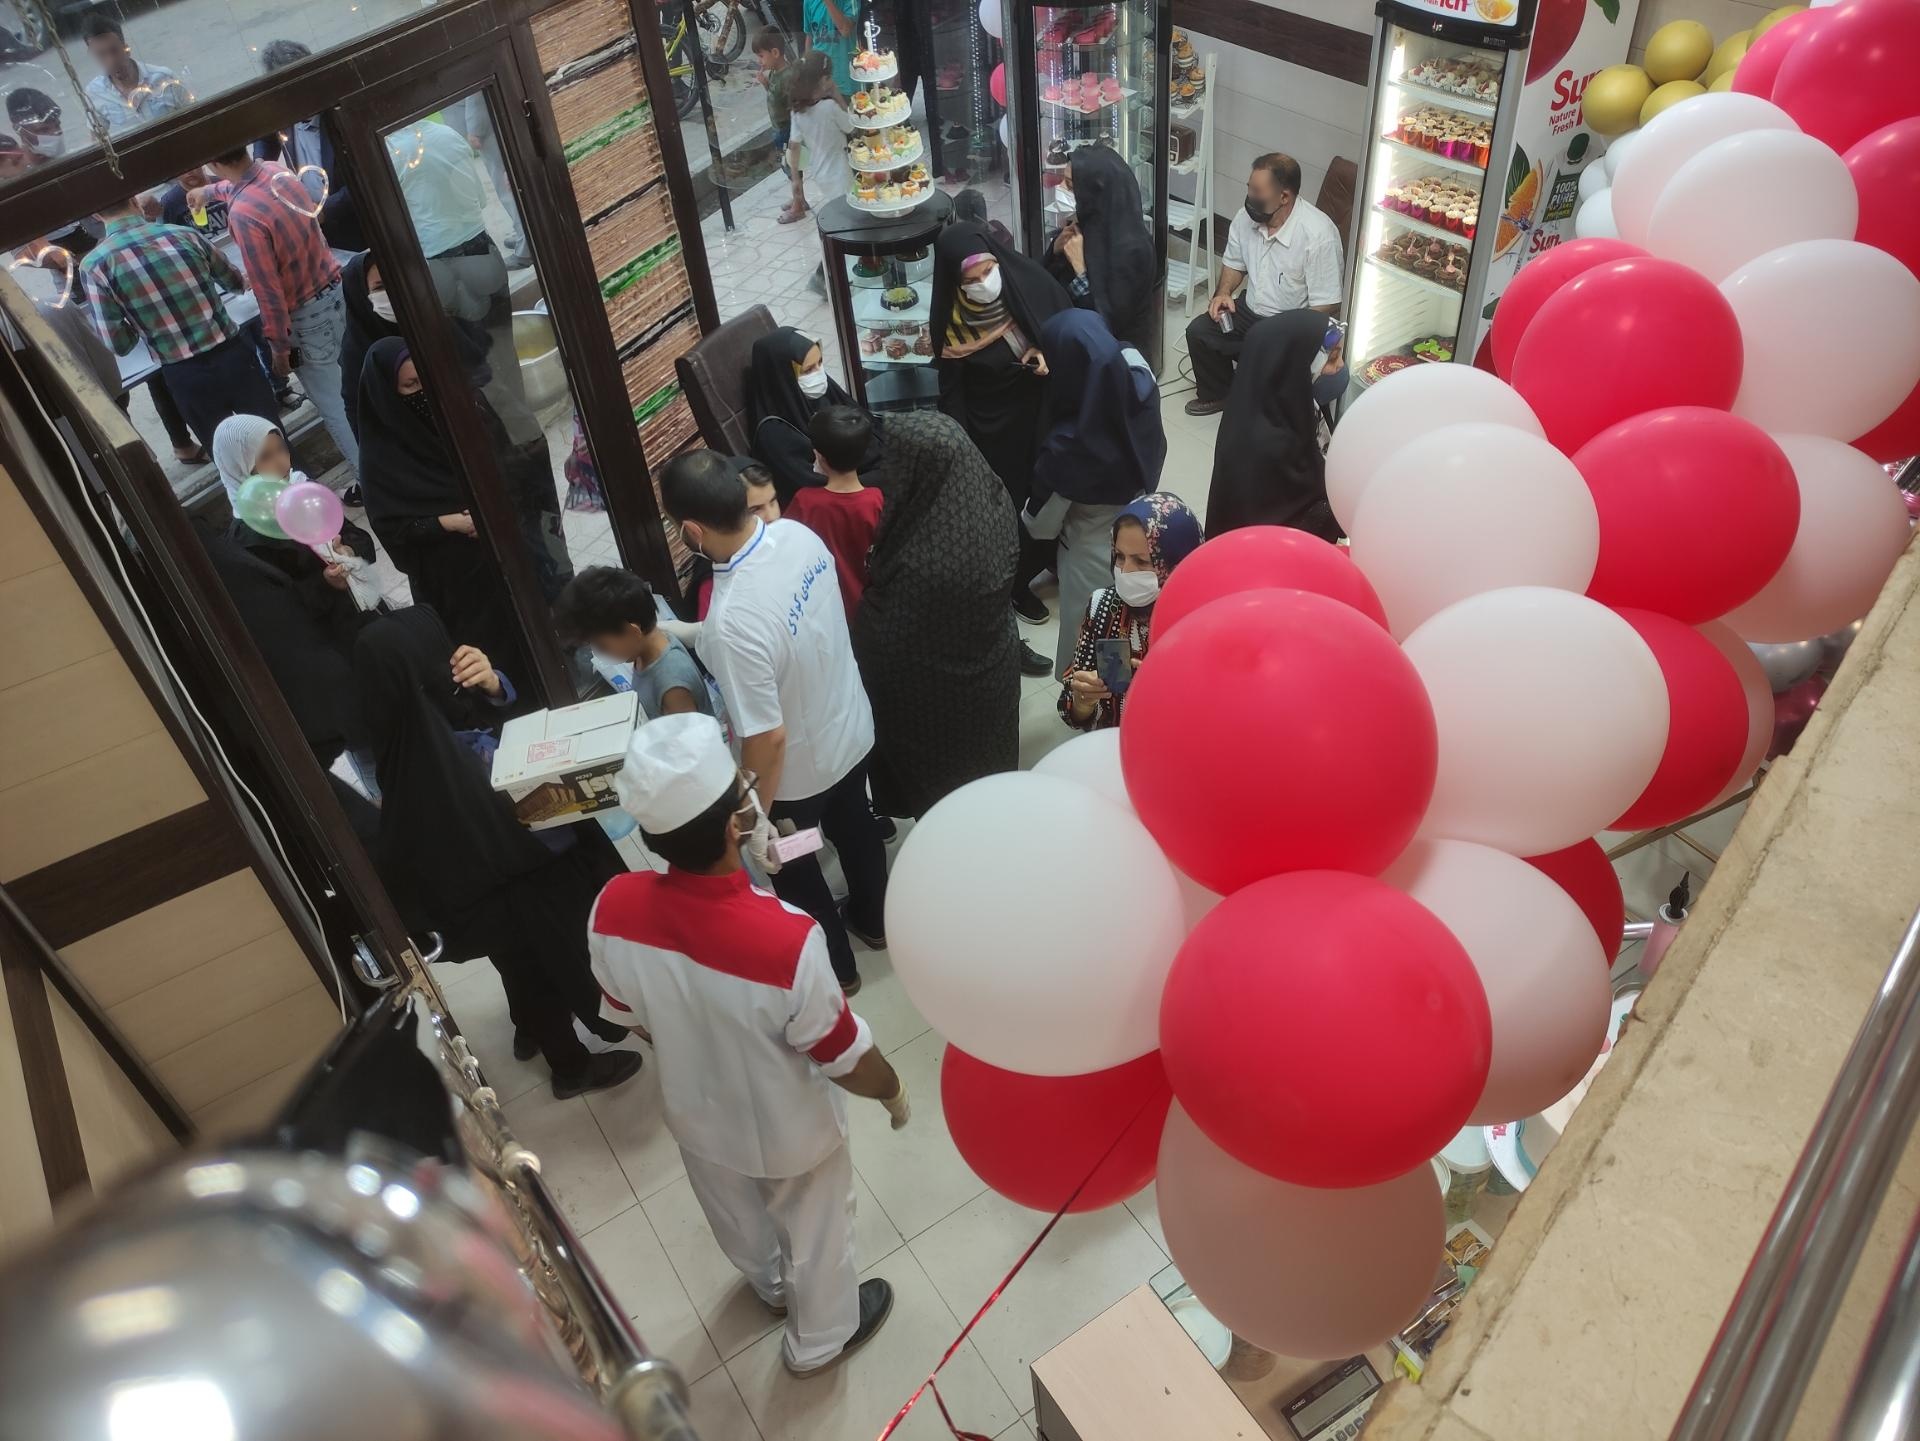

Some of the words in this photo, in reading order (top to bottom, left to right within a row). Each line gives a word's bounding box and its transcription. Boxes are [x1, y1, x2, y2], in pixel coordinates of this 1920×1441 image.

[1549, 108, 1577, 127] Nature
[1552, 118, 1574, 136] Fresh
[1555, 181, 1578, 194] 100%
